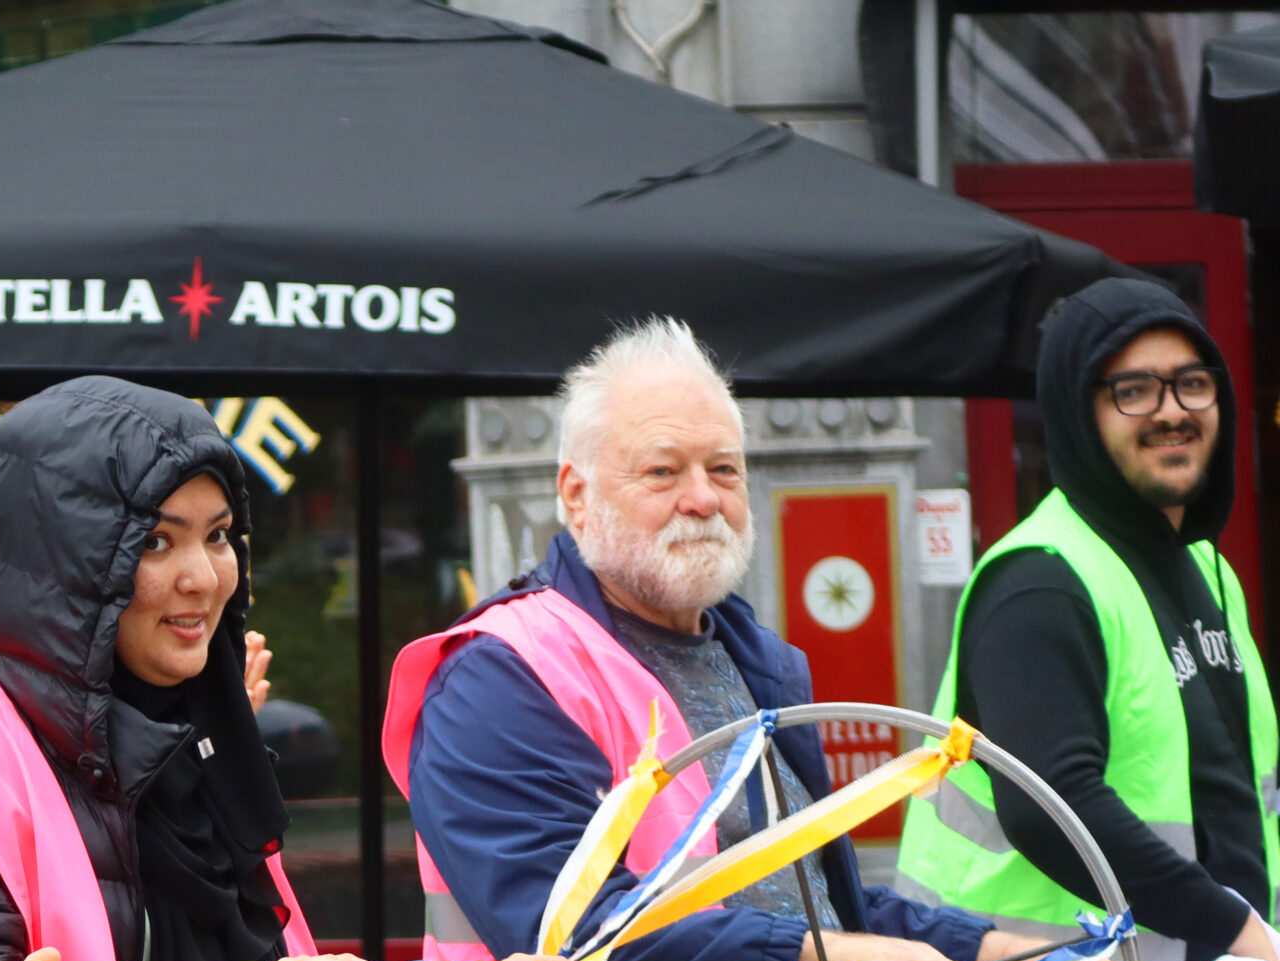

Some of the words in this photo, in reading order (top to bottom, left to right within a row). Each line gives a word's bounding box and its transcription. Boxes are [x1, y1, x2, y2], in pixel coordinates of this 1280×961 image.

[229, 281, 455, 333] ARTOIS
[819, 720, 892, 743] ELLA
[824, 751, 893, 784] TOI
